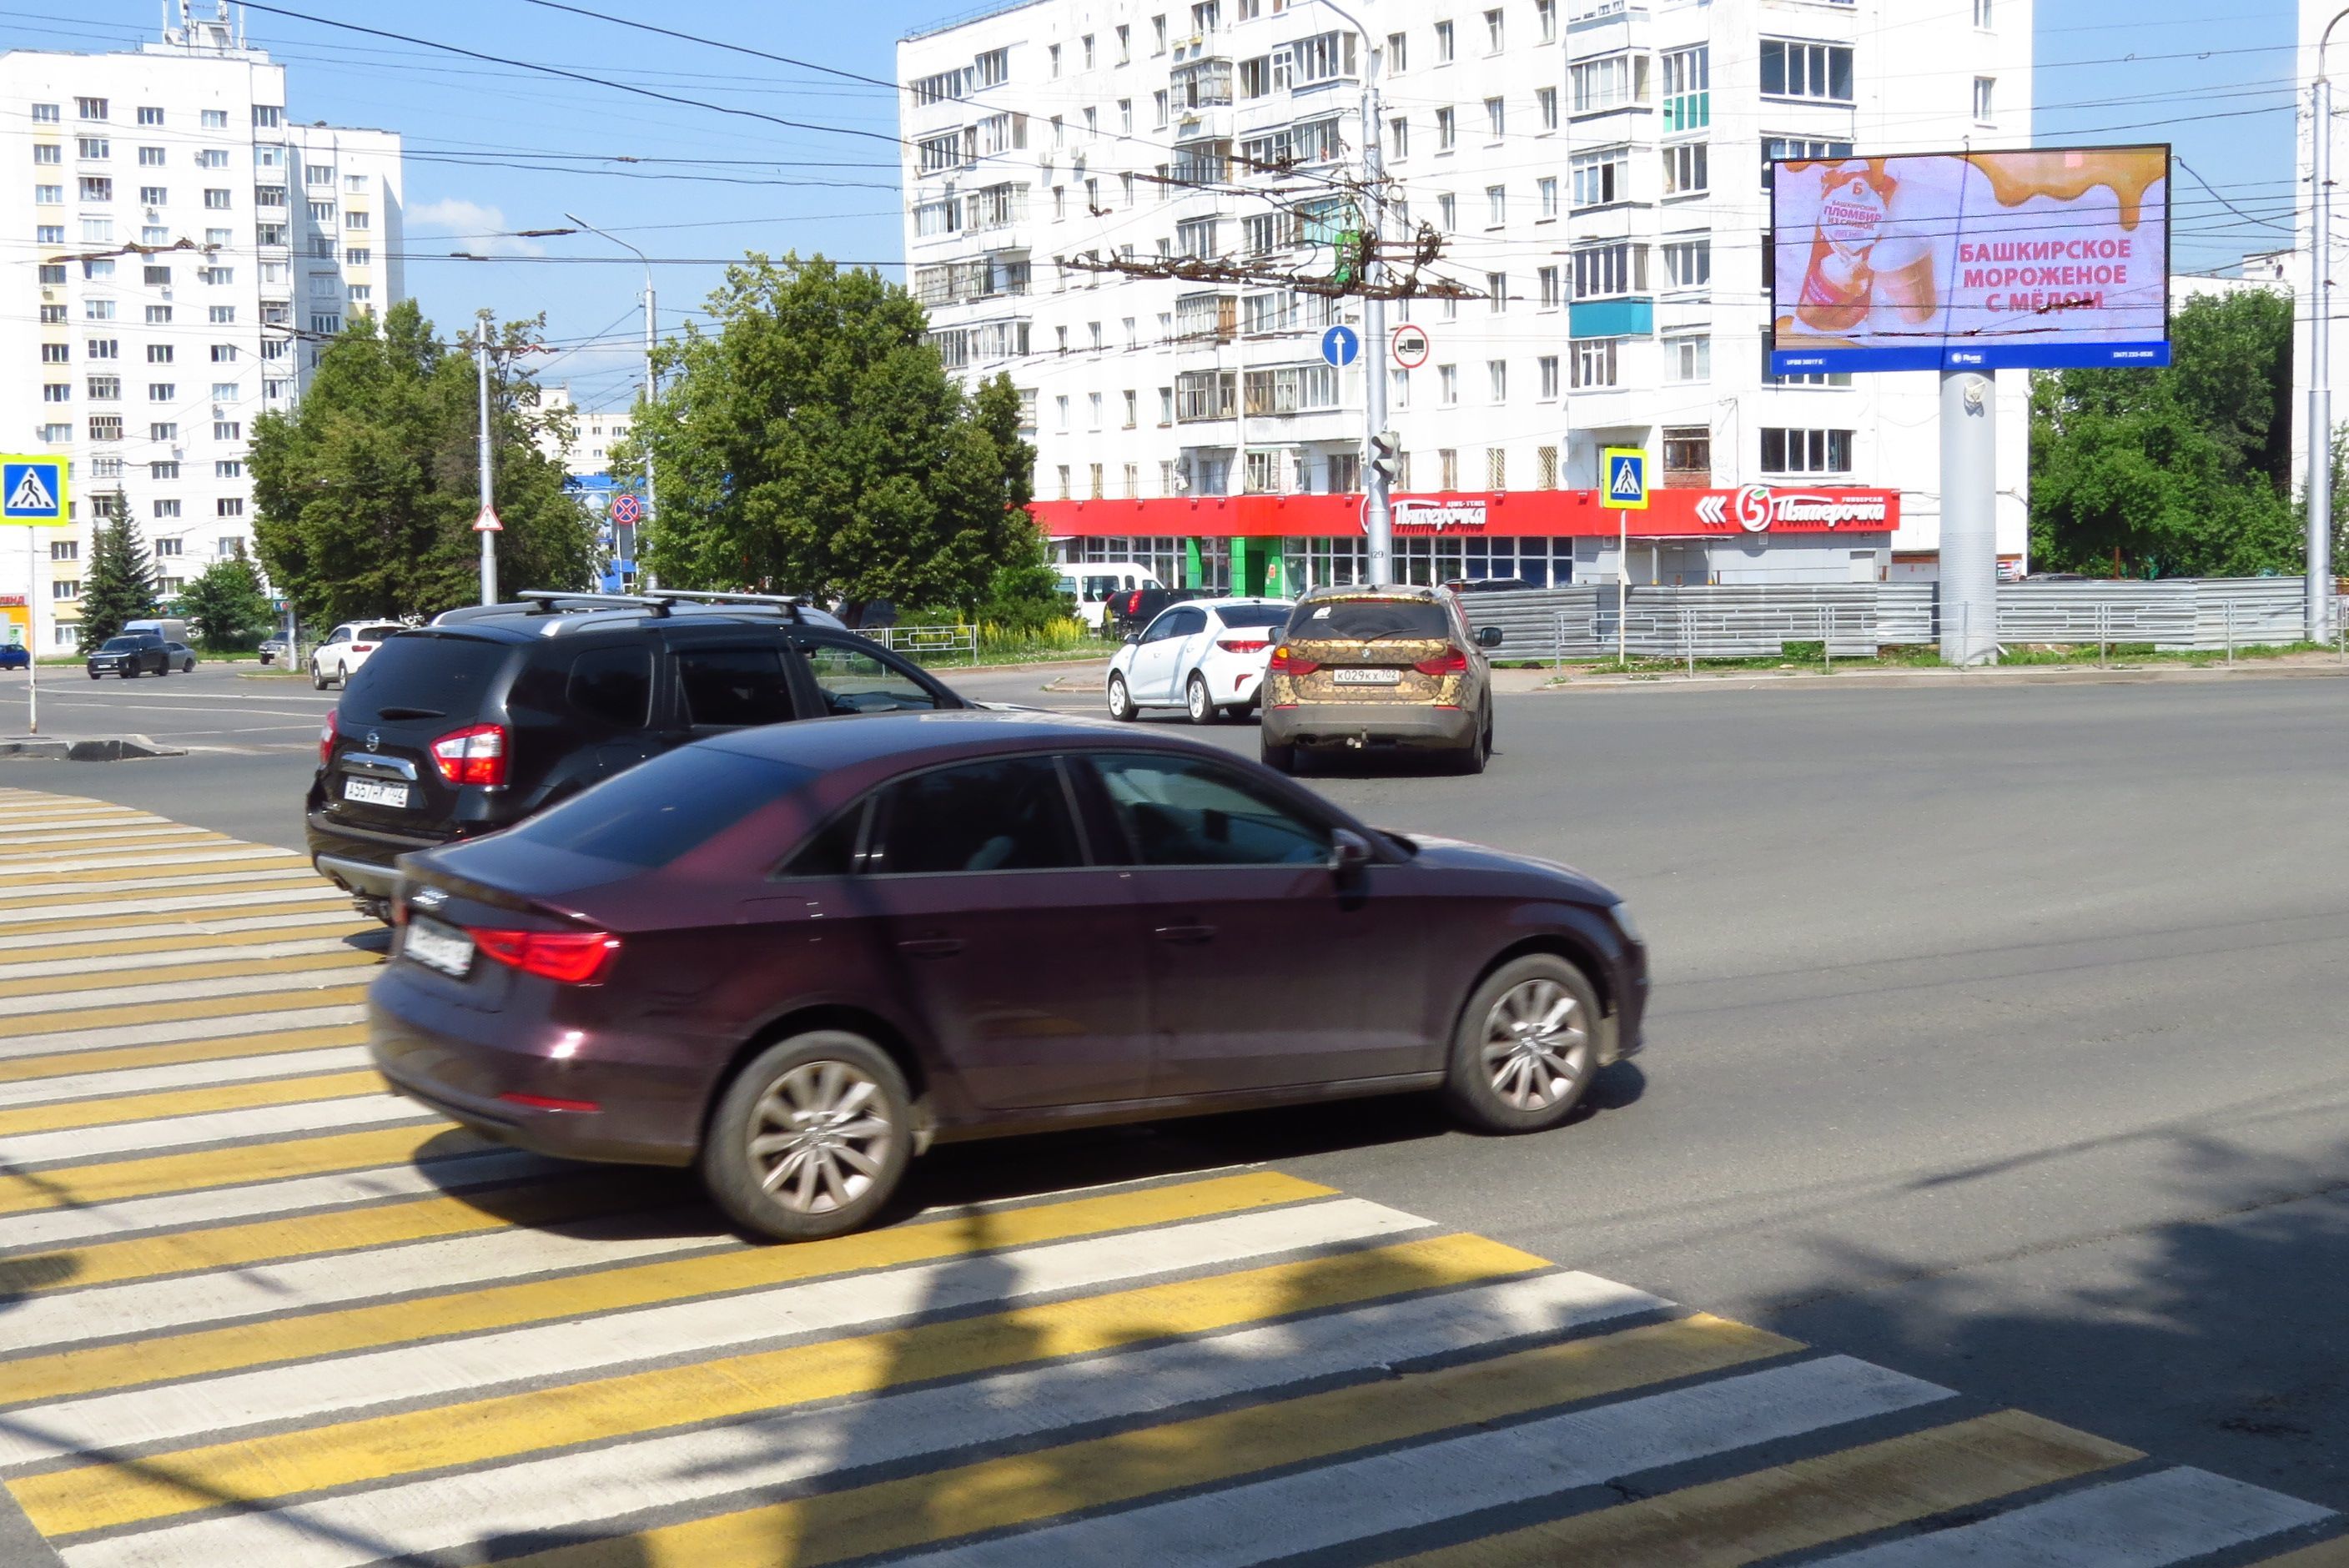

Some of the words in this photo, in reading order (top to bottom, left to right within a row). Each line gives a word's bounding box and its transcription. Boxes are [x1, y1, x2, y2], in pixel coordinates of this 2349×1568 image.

[1823, 205, 1882, 221] ПЛОМБИР
[1960, 239, 2131, 263] БАШКИРСКОЕ
[1964, 264, 2127, 288] МОРОЖЕНОЕ
[1985, 294, 2001, 313] С
[2009, 289, 2104, 314] МЁДОМ
